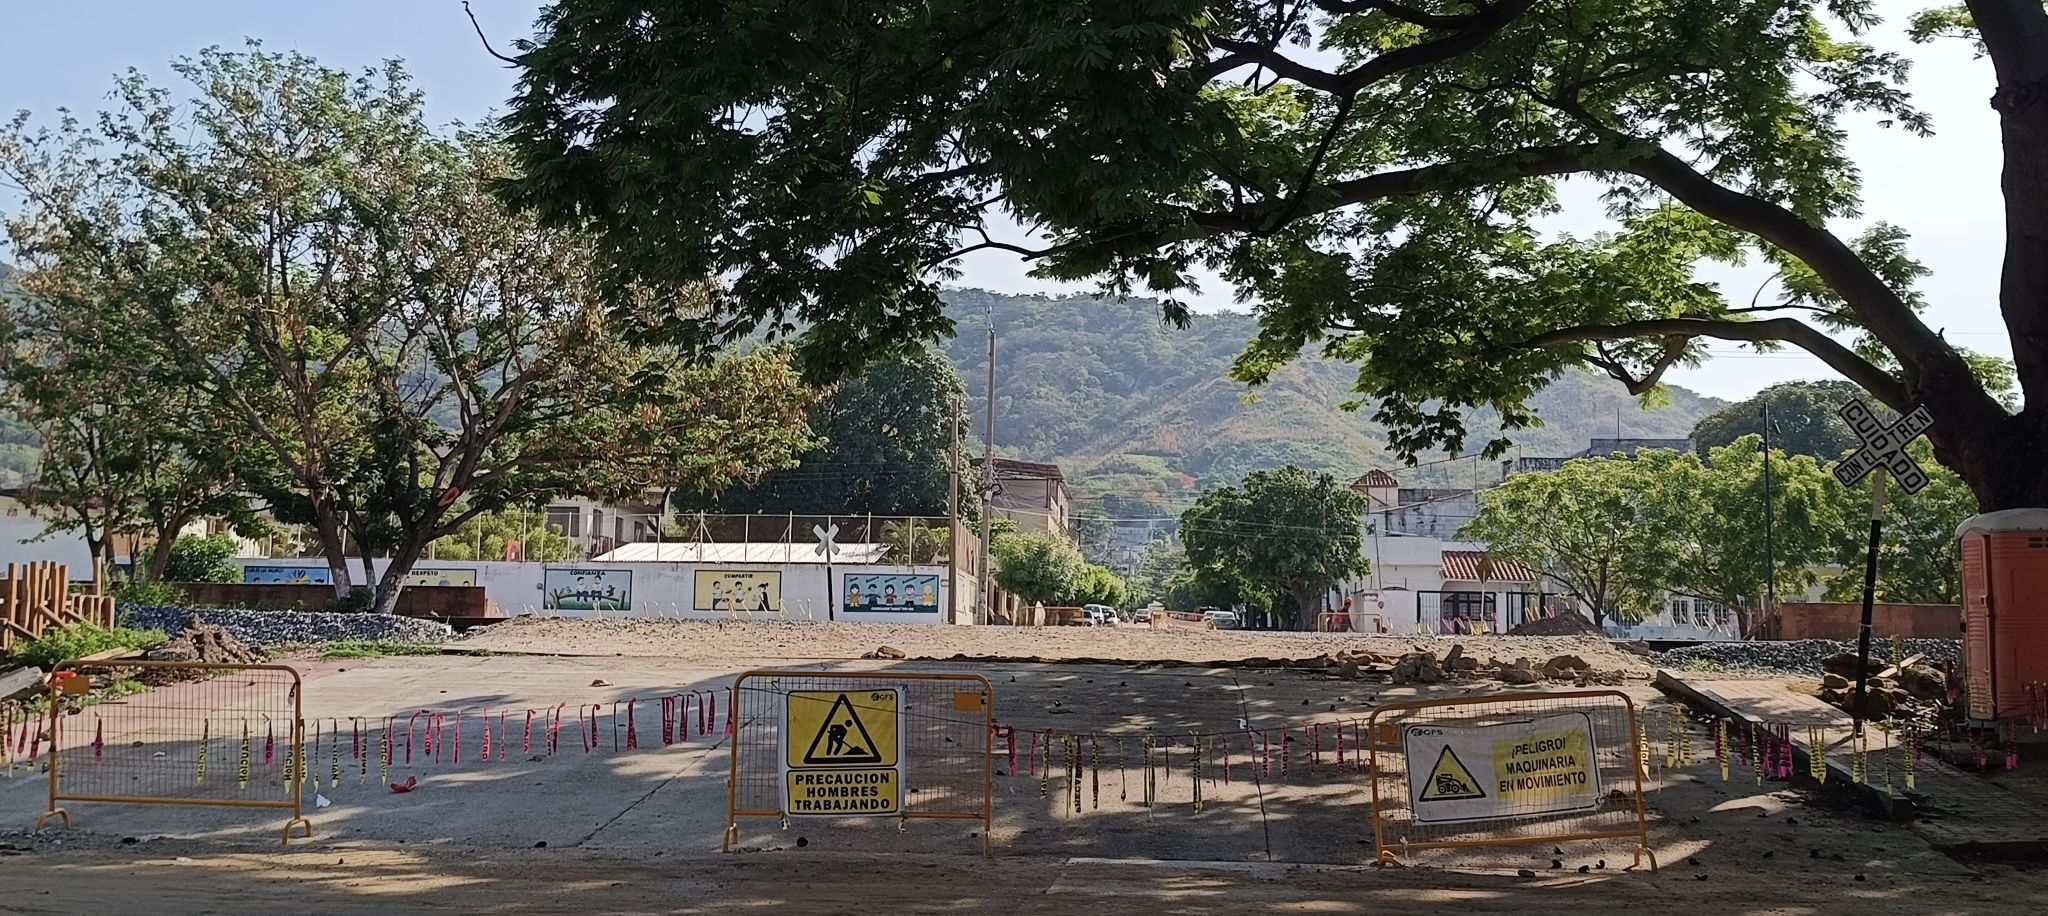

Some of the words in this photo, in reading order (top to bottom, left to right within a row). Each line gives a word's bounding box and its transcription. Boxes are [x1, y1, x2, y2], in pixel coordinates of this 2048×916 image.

[1837, 457, 1865, 483] CON
[1860, 449, 1883, 467] EL
[1886, 410, 1931, 444] TREN
[1846, 405, 1922, 489] CUIDADO
[1511, 737, 1567, 759] ¡PELIGRO!
[1505, 755, 1576, 775] MAQUINARIA
[795, 773, 890, 785] PRECAUCION
[1499, 779, 1515, 792] EN
[1517, 771, 1587, 790] MOVIMIENTO
[806, 786, 879, 798] HOMBRES
[794, 799, 890, 811] TRABAJANDO
